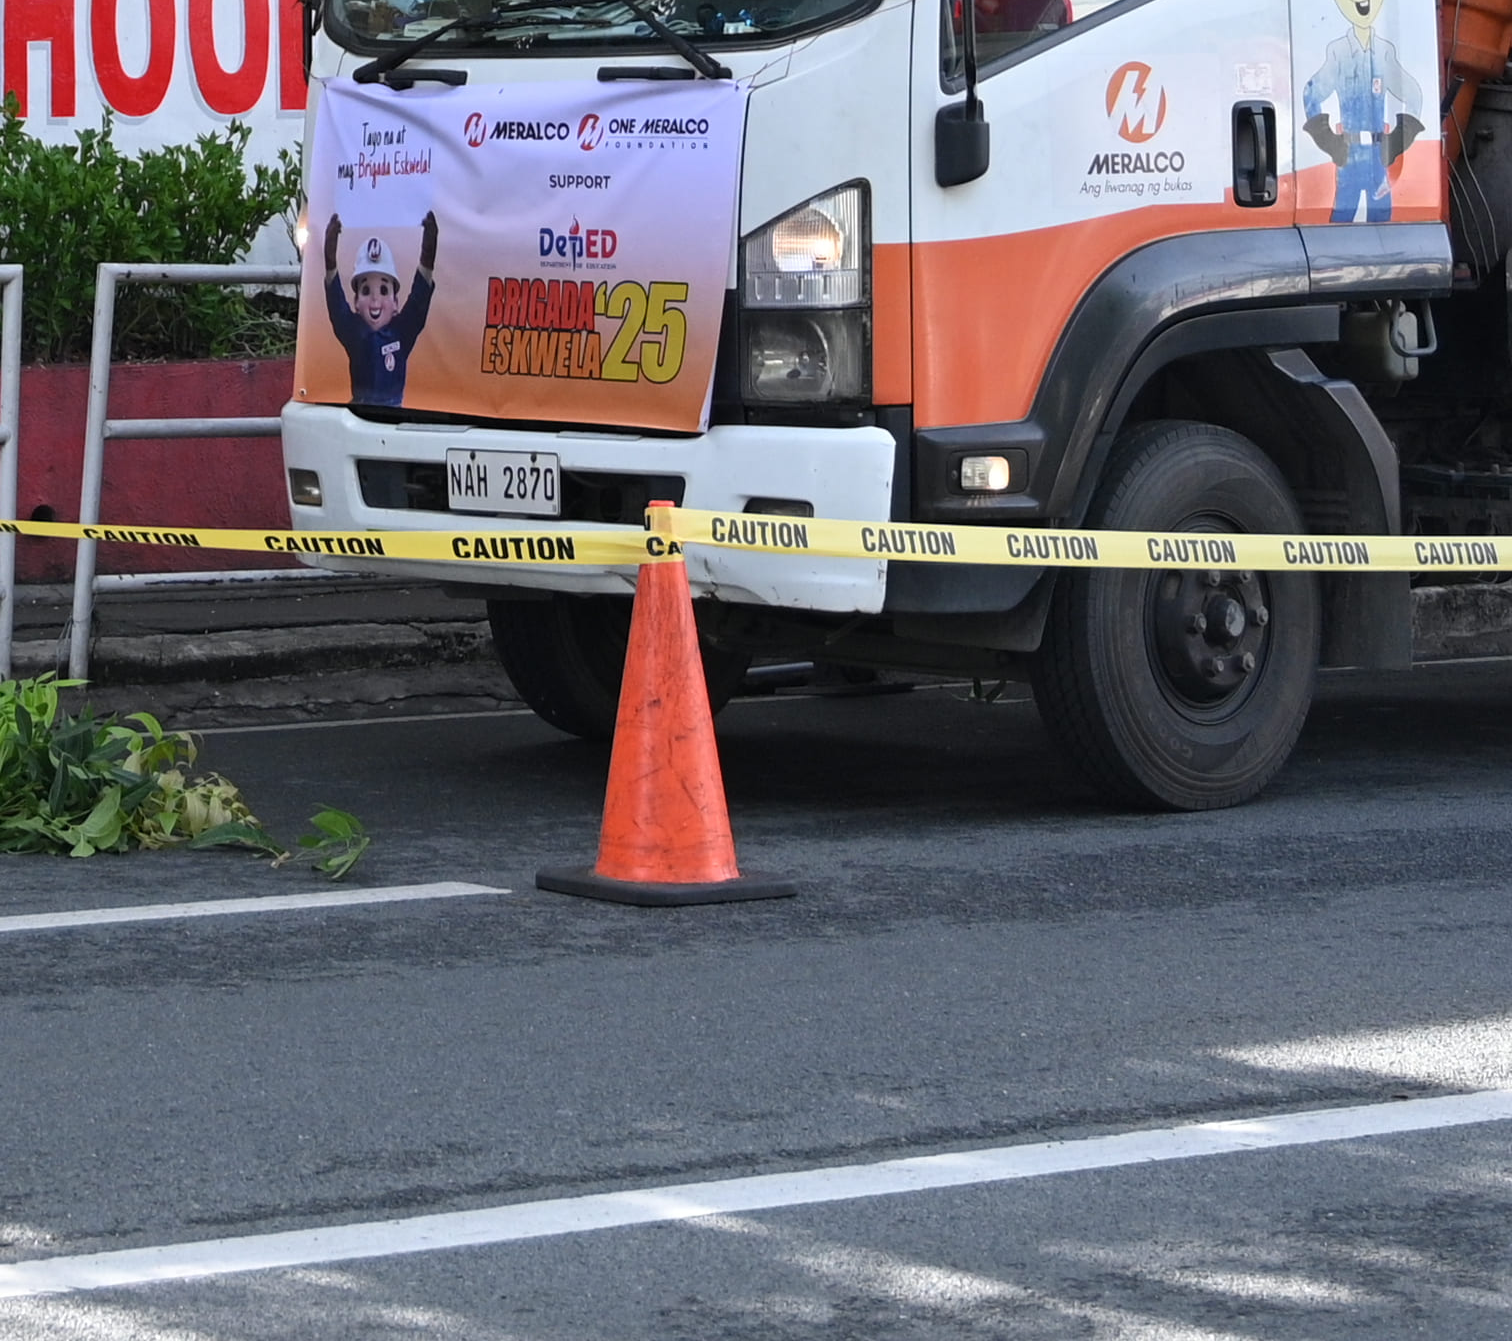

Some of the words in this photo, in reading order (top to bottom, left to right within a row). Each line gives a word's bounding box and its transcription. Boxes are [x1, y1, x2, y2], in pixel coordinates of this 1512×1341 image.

[362, 122, 382, 157] Tayo
[396, 125, 407, 145] at
[488, 121, 570, 141] MERALCO
[608, 118, 636, 135] ONE
[638, 118, 710, 135] MERALCO
[604, 141, 709, 150] FOUNDATION
[393, 147, 432, 176] Eskwela!
[1087, 150, 1185, 175] MERALCO
[549, 174, 612, 189] SUPPORT
[1079, 178, 1102, 198] Ang
[1104, 178, 1145, 199] liwanag
[1147, 182, 1161, 196] ng
[1163, 176, 1193, 192] bukas
[485, 277, 595, 331] BRIGADA
[481, 325, 602, 380] ESKWELA
[450, 461, 489, 497] NAH
[502, 466, 555, 502] 2870
[82, 527, 201, 547] CAUTION
[264, 536, 385, 556] CAUTION
[451, 536, 575, 560] CAUTION
[711, 517, 809, 549] CAUTION
[861, 526, 956, 556] CAUTION
[1006, 533, 1099, 561] CAUTION
[1146, 537, 1237, 564] CAUTION
[1283, 540, 1370, 565] CAUTION
[1414, 541, 1499, 566] CAUTION
